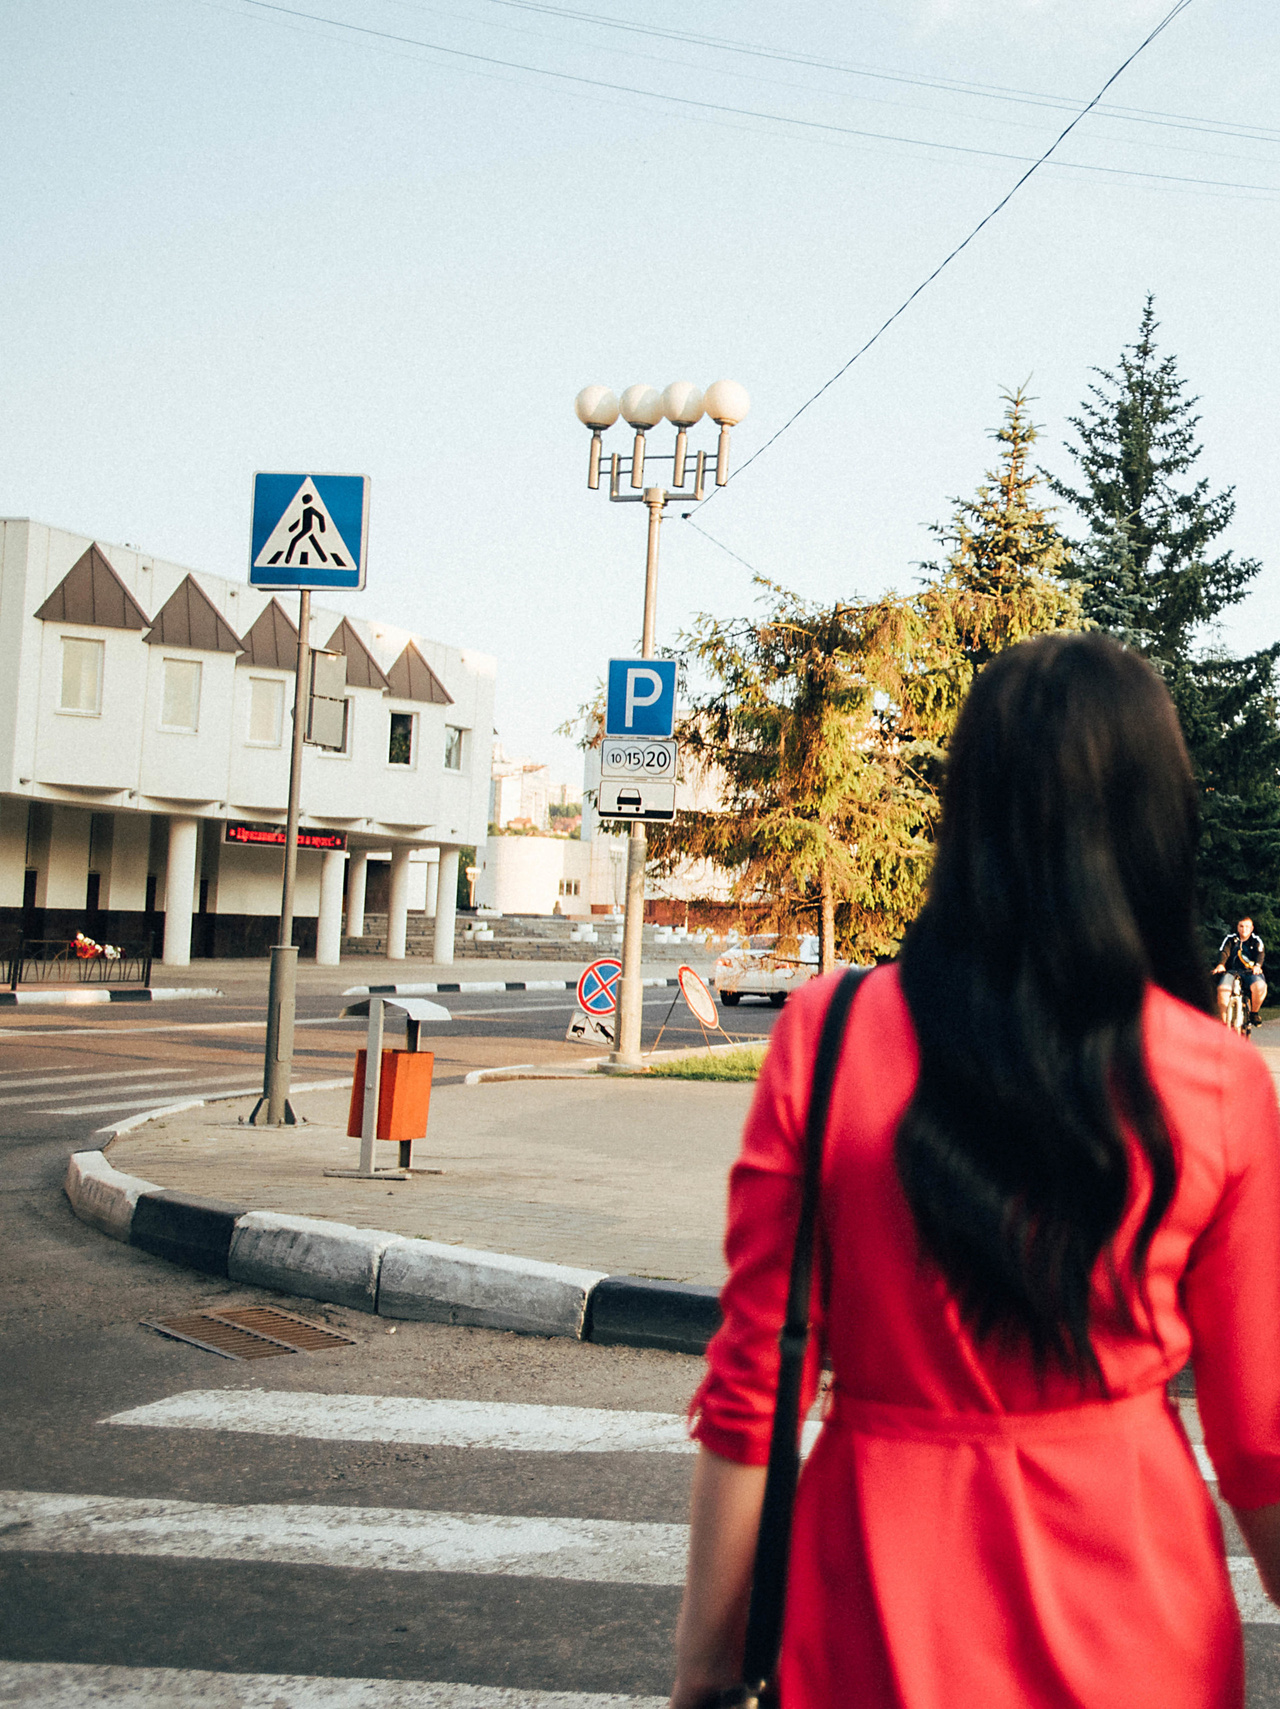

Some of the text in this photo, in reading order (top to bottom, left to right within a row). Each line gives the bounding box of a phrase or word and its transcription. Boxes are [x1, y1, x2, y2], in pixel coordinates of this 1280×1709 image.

[625, 668, 663, 728] P
[611, 751, 667, 768] 10 15 20
